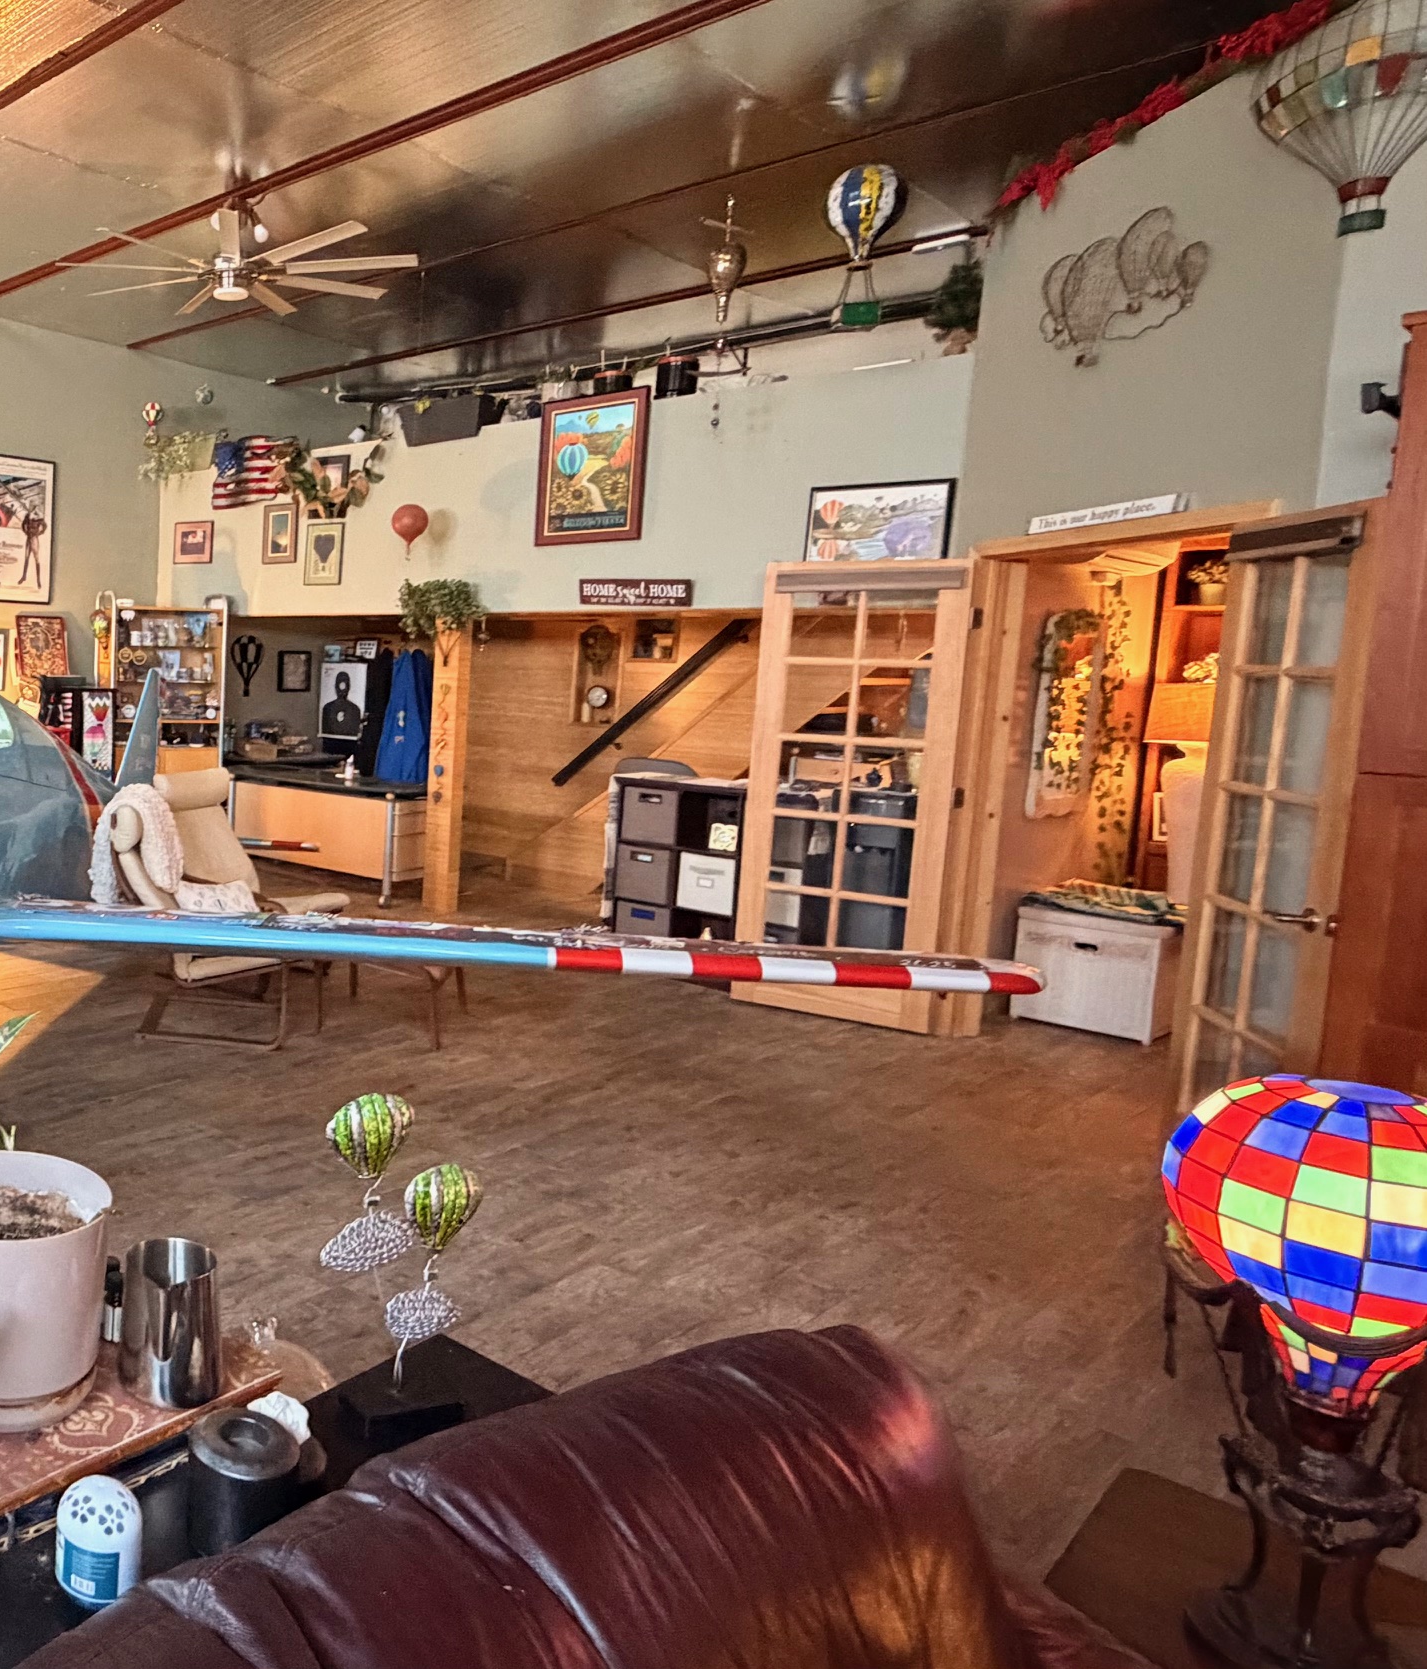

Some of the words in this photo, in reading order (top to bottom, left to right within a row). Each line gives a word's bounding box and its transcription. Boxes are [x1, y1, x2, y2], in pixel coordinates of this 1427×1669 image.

[1038, 518, 1057, 529] This
[1059, 515, 1068, 526] is
[1089, 507, 1120, 522] happy
[1124, 502, 1156, 517] place.
[582, 583, 616, 597] HOME
[616, 581, 648, 598] sweet
[648, 584, 687, 598] HOME
